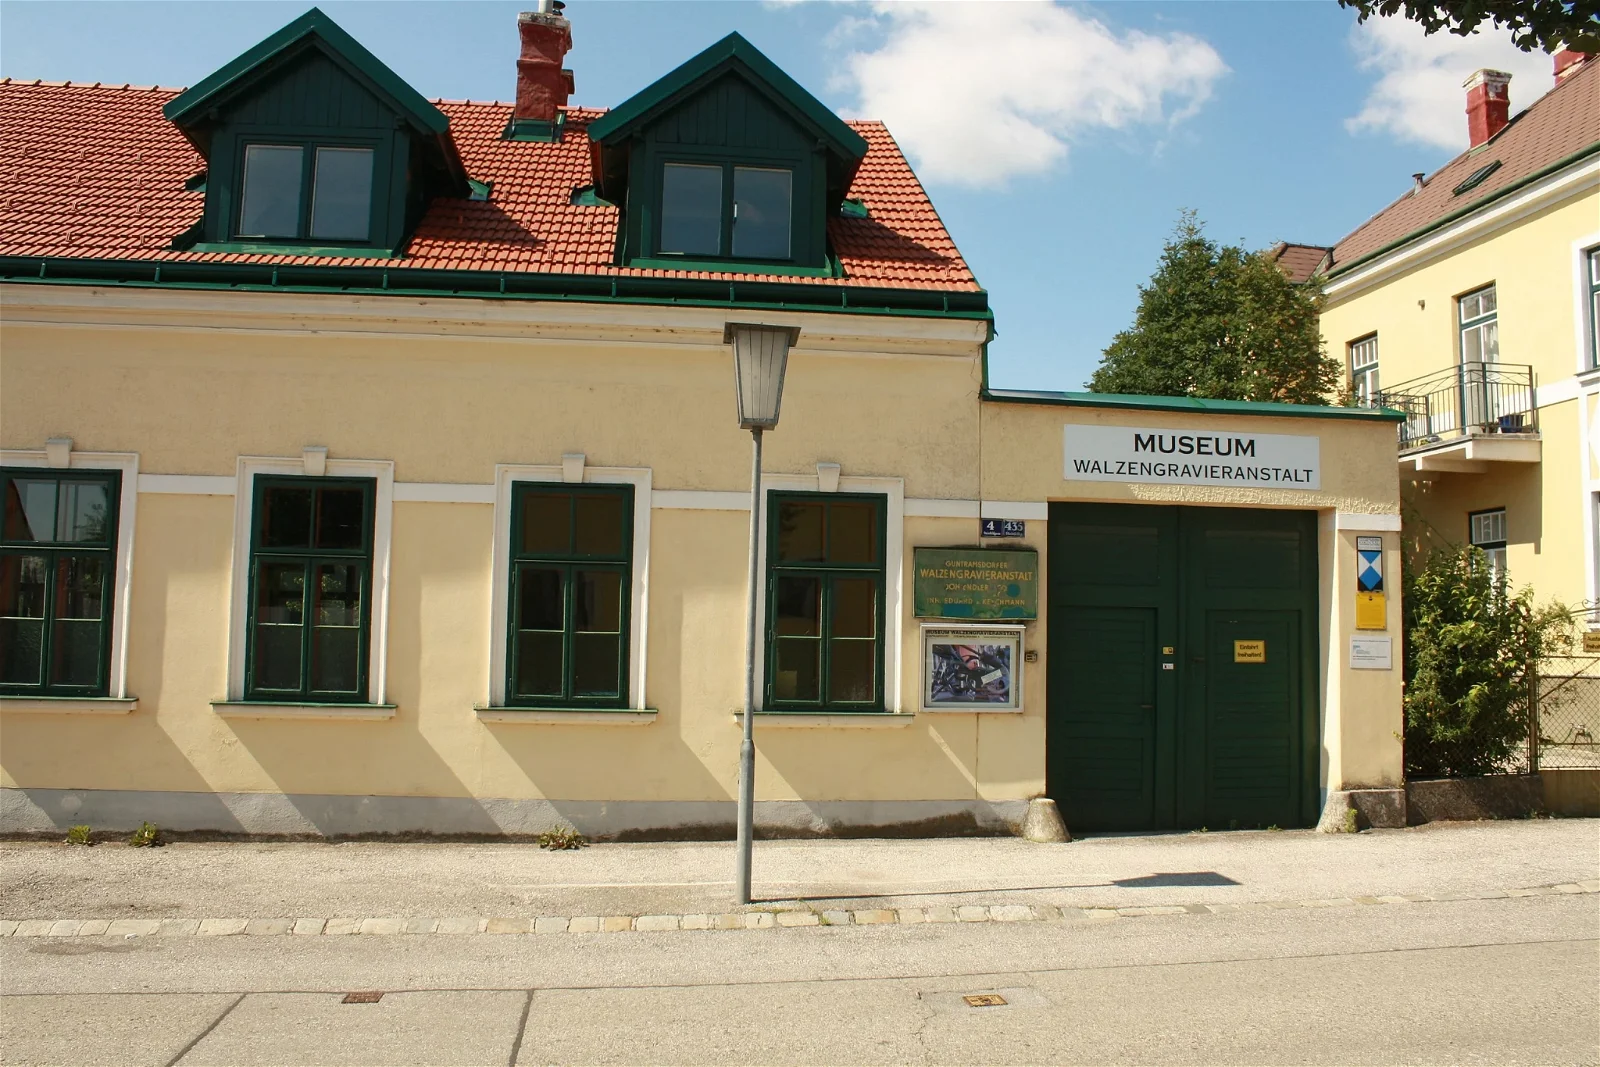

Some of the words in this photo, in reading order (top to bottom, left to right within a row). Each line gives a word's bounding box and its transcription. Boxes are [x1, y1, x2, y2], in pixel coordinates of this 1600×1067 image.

[1134, 433, 1256, 458] MUSEUM
[1073, 459, 1314, 483] WALZENGRAVIERANSTALT
[986, 520, 995, 531] 4
[1004, 521, 1023, 531] 435
[920, 569, 1033, 581] WALZENGRAVIERANSTALT
